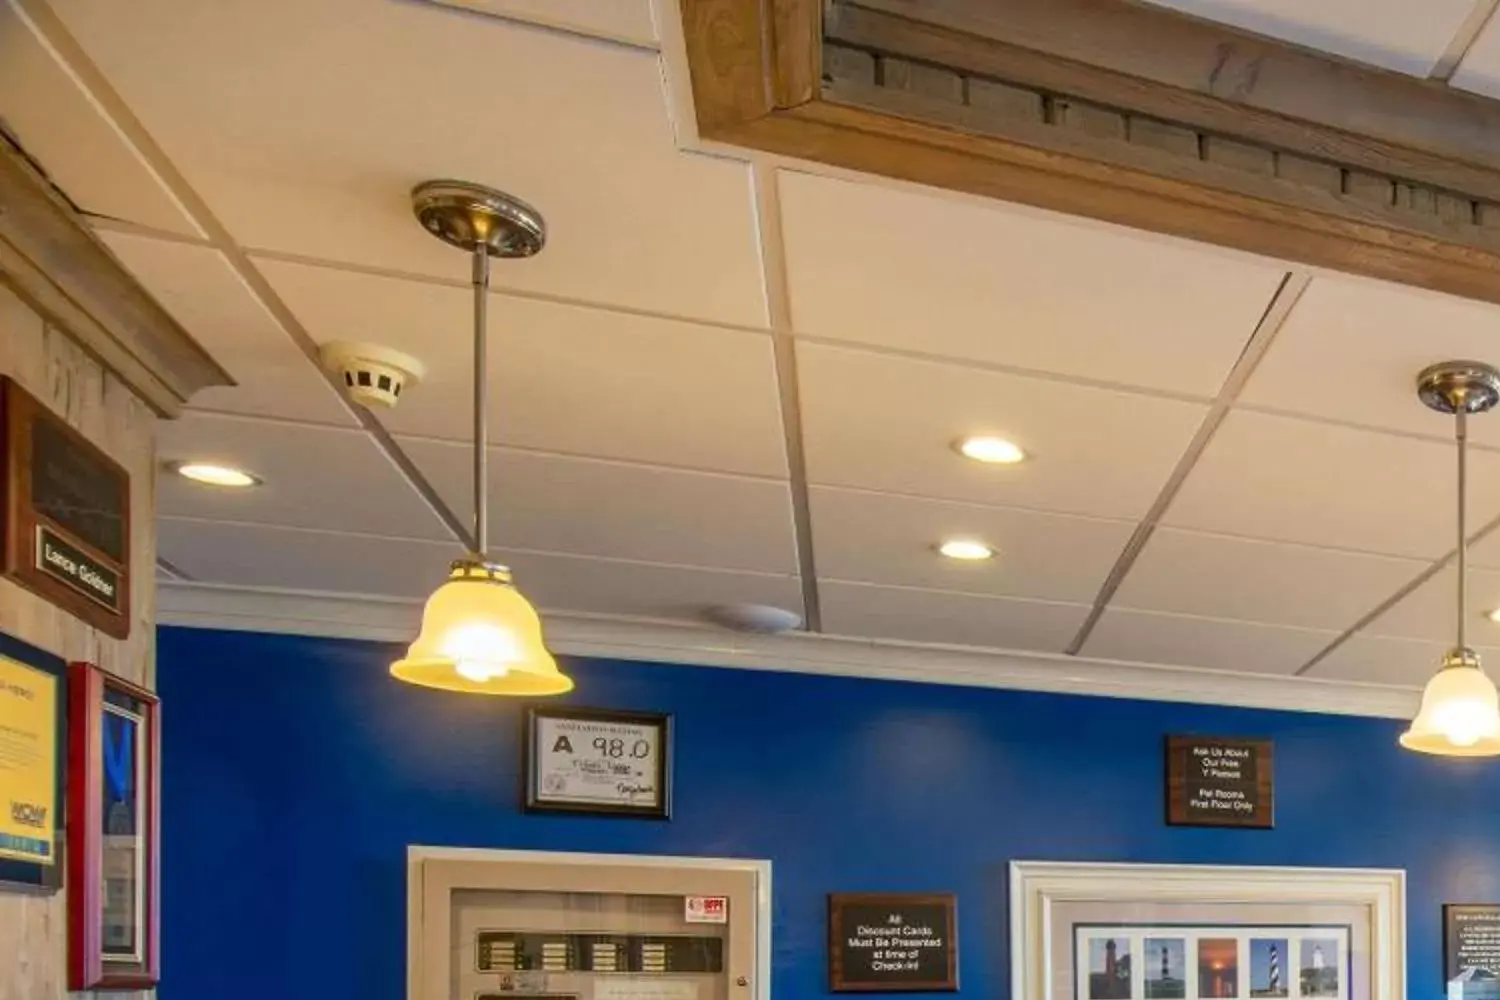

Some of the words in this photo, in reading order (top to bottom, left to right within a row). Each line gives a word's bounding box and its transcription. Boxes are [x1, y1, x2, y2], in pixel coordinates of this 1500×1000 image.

[45, 543, 77, 575] Lance
[552, 735, 574, 754] A
[592, 737, 650, 759] 98.0
[857, 925, 901, 936] Discount
[902, 925, 933, 936] Cards
[848, 938, 874, 948] Must
[875, 938, 889, 948] Be
[891, 938, 942, 948] Presented
